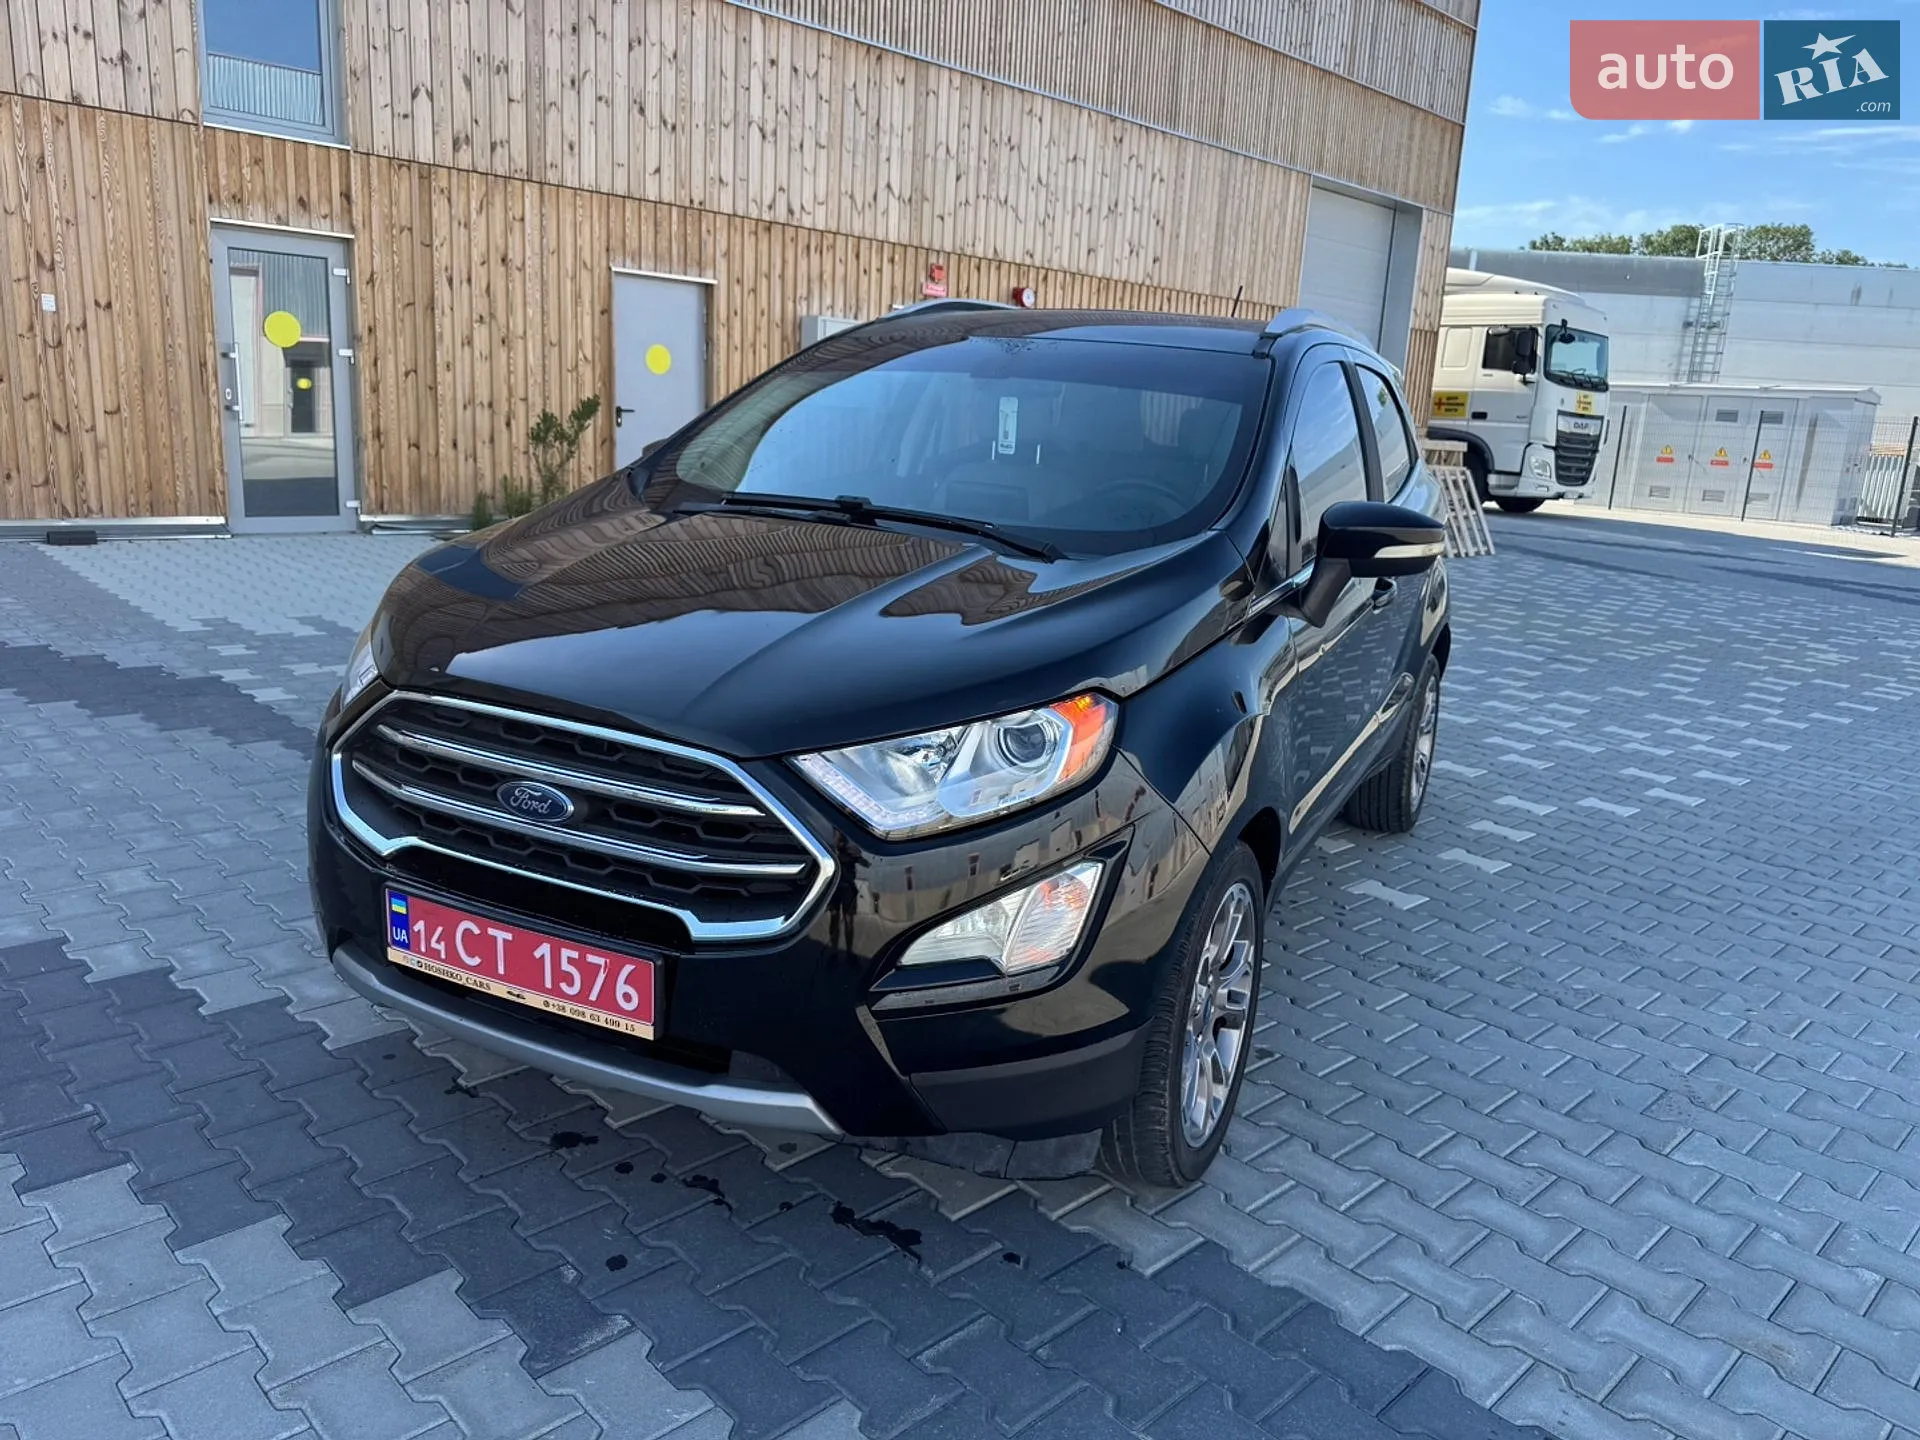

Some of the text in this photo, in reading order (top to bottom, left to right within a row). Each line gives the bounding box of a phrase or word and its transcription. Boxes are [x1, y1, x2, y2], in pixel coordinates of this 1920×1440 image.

[510, 786, 552, 814] Ford
[393, 926, 409, 944] UA
[533, 942, 640, 1012] 1576
